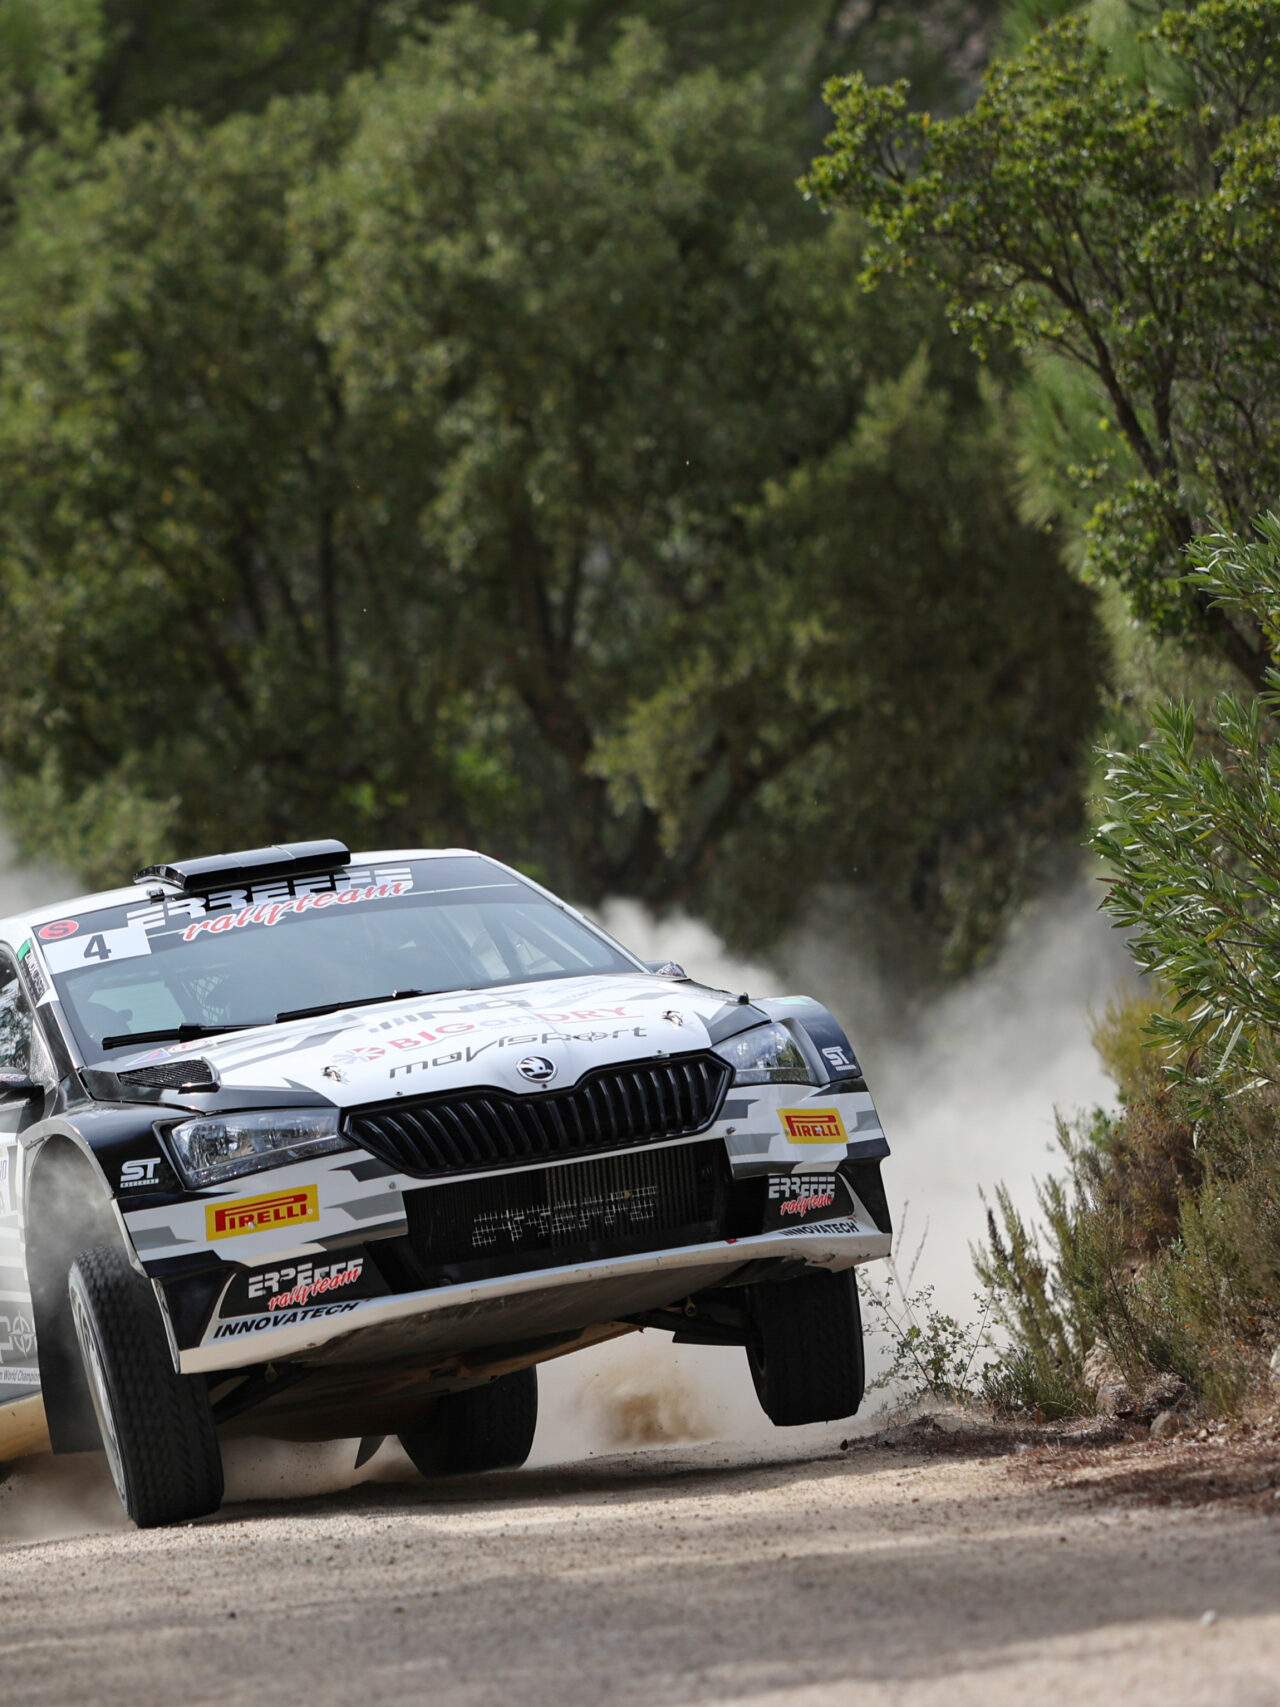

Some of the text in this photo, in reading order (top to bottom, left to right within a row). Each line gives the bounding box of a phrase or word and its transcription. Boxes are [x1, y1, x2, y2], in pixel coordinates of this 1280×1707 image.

[83, 933, 112, 961] 4
[821, 1045, 850, 1066] ST
[785, 1114, 841, 1137] PIRELLI
[120, 1157, 162, 1182] ST
[215, 1193, 308, 1233] PIRELLI
[778, 1221, 860, 1237] INNOVATECH
[213, 1301, 360, 1339] INNOVATECH
